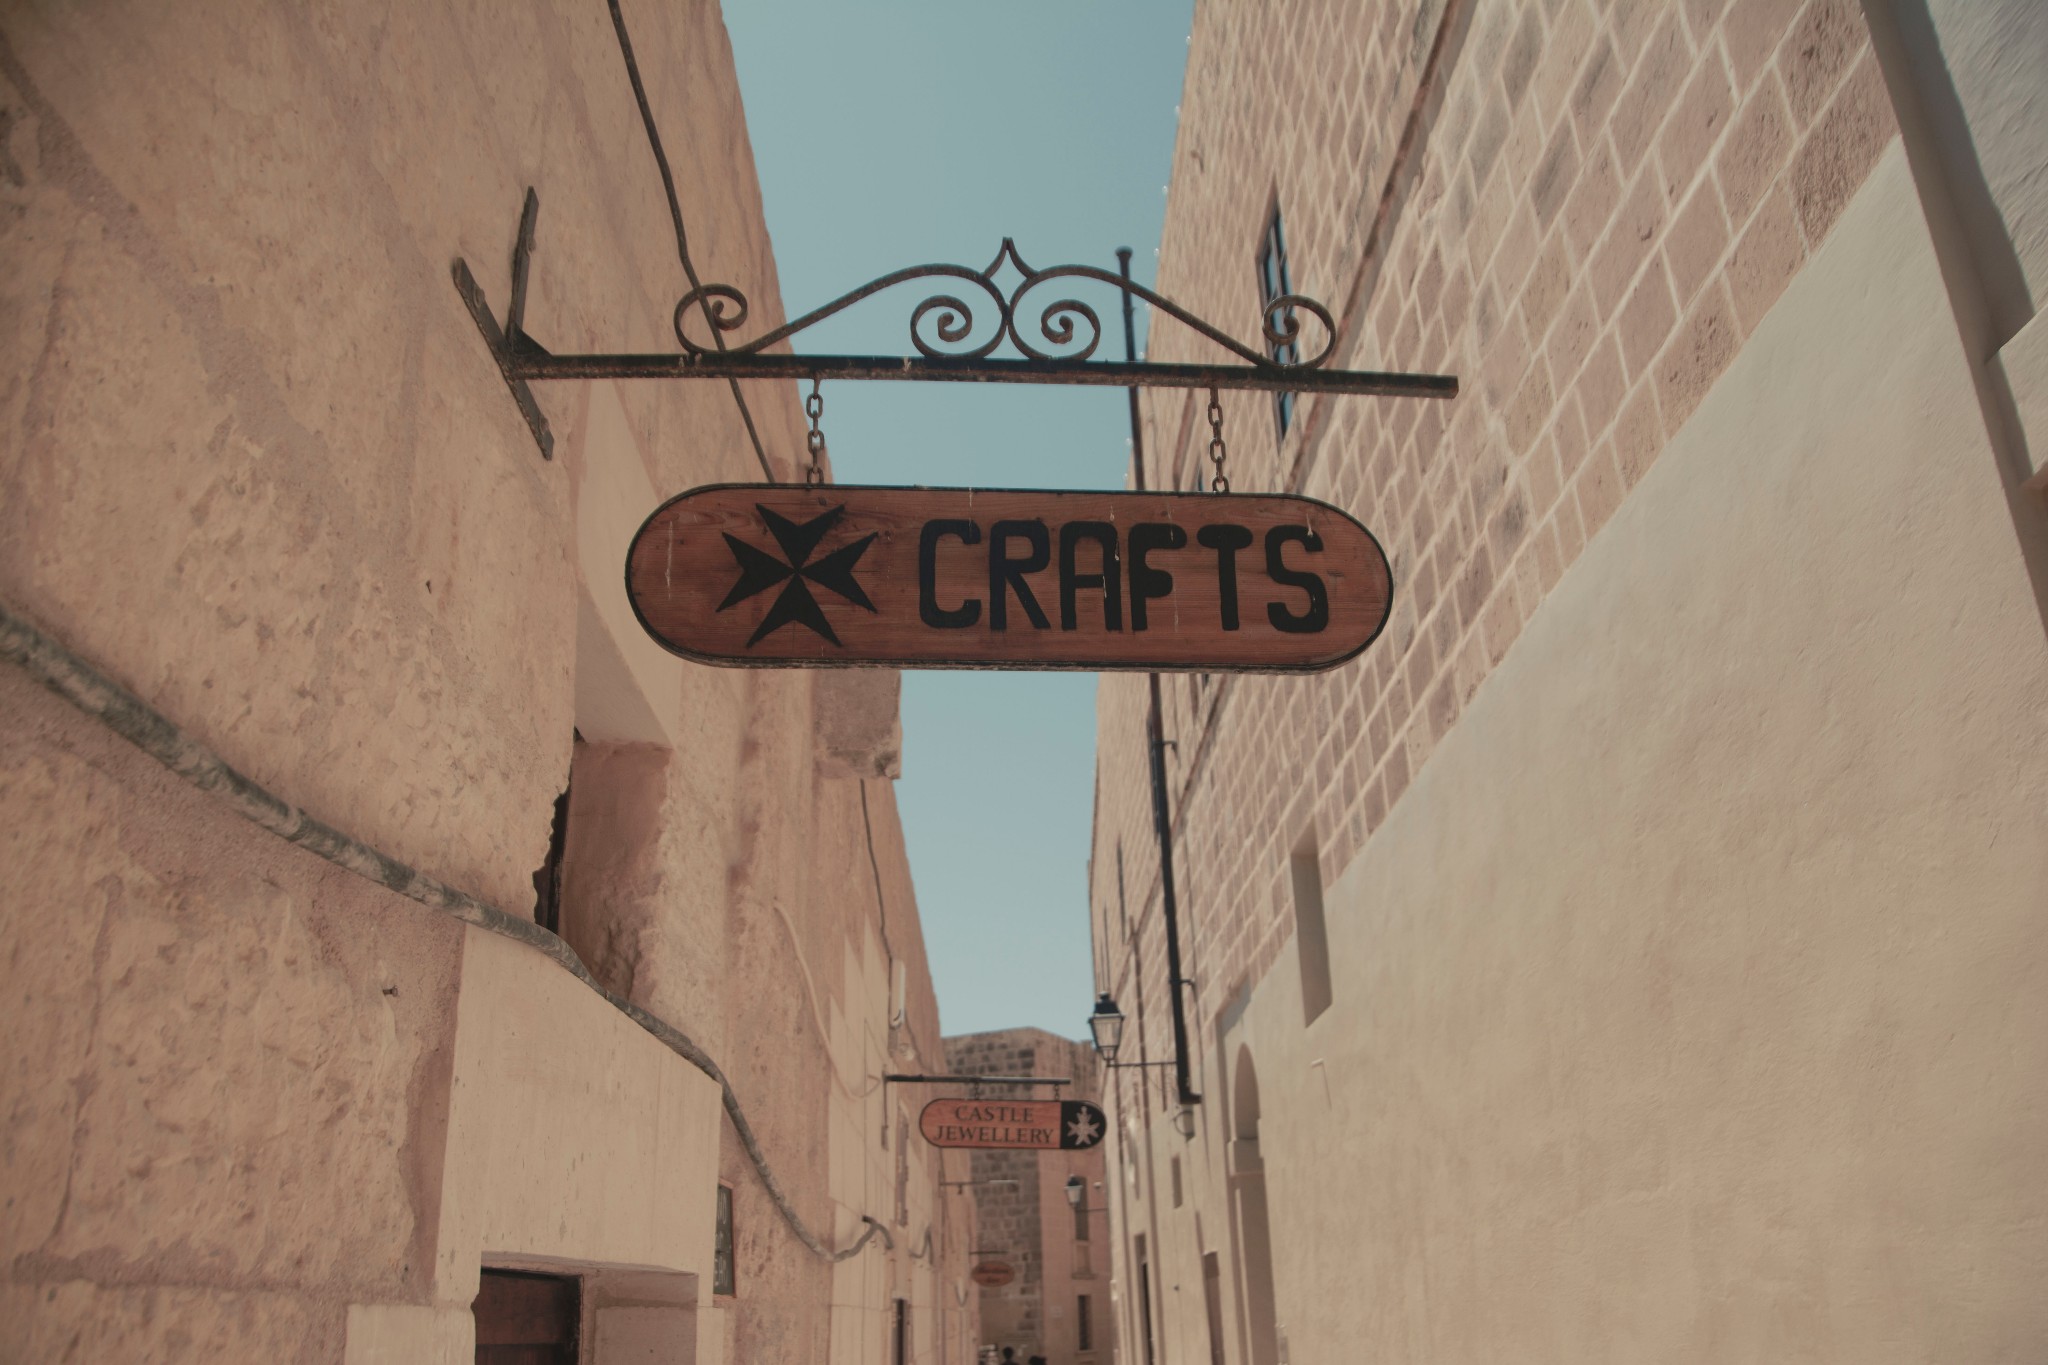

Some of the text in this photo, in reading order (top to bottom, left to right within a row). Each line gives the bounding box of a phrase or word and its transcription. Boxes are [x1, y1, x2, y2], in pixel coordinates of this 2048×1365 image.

[919, 519, 1329, 633] CRAFTS
[955, 1105, 1034, 1123] CASTLE
[934, 1125, 1054, 1144] JEWELLERY
